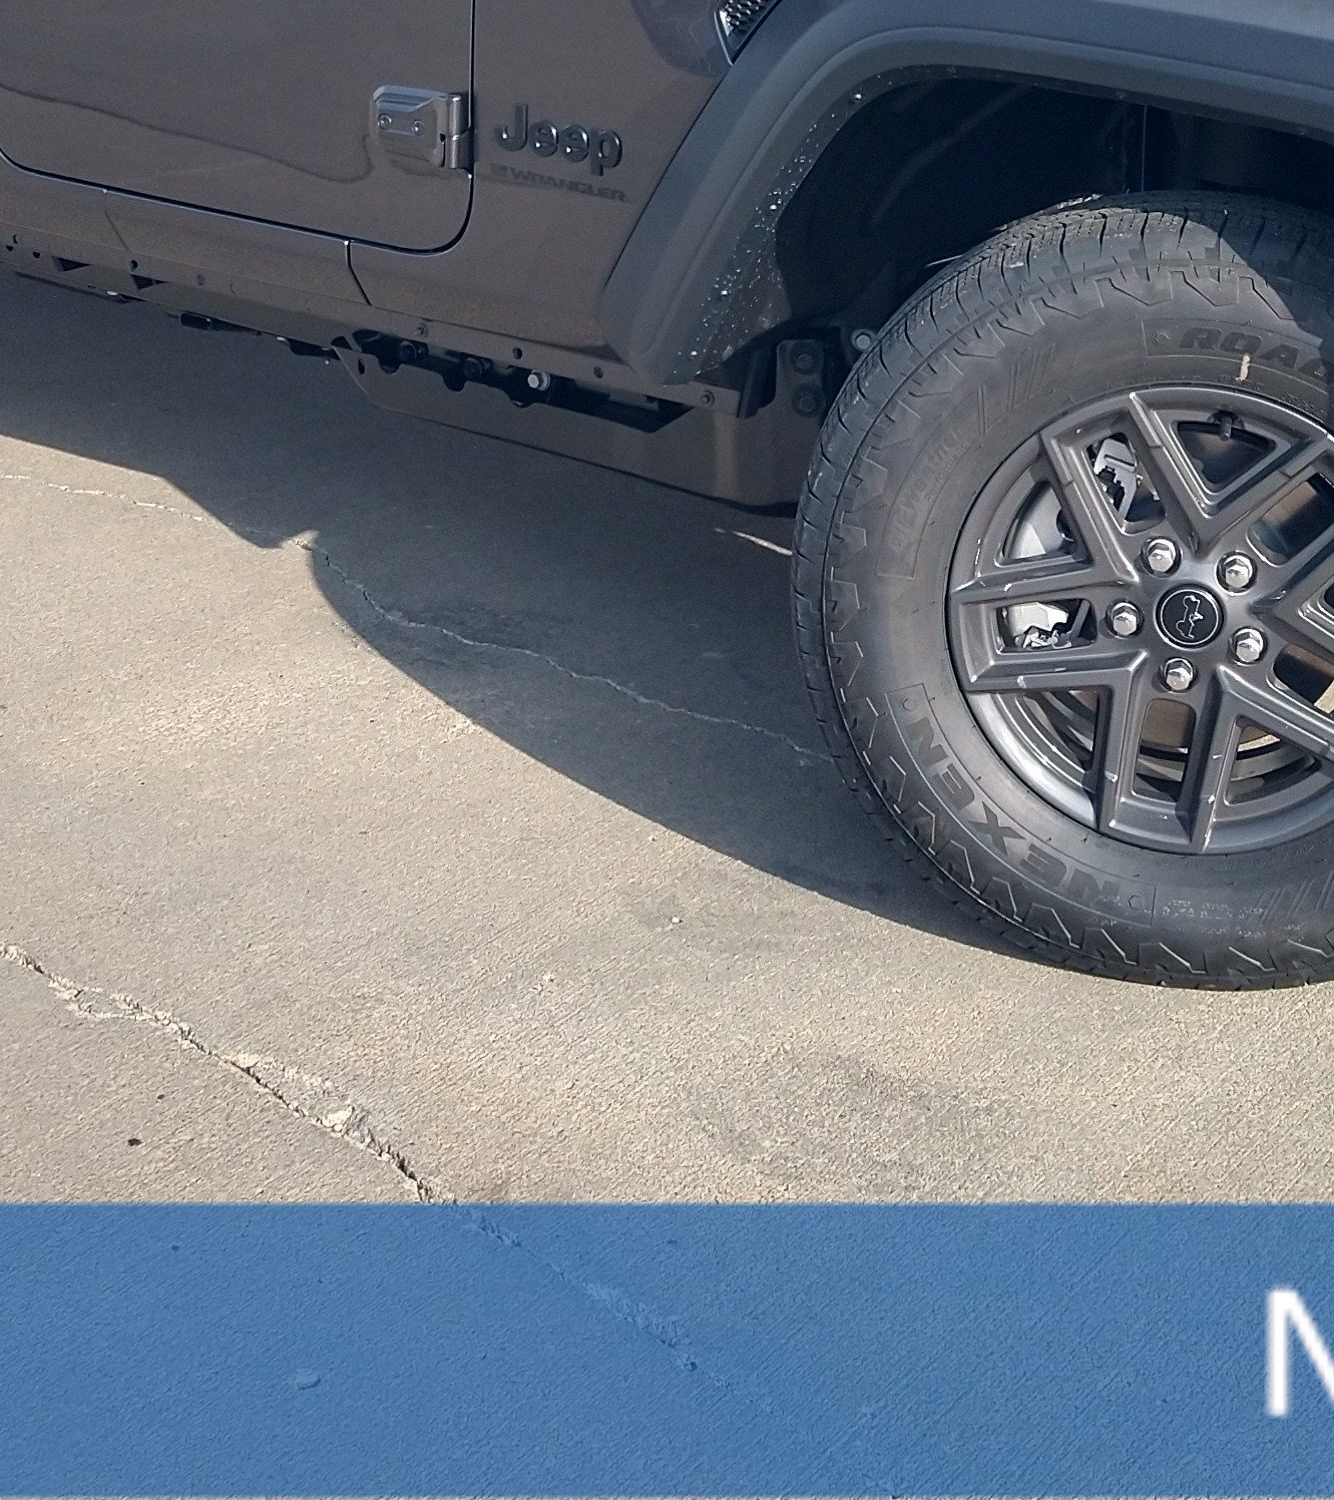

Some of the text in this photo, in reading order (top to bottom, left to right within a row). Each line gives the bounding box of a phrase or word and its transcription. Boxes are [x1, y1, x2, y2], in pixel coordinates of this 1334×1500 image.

[495, 103, 624, 177] Jeep
[509, 166, 626, 204] WRANGLER
[905, 716, 1122, 902] NEXEN
